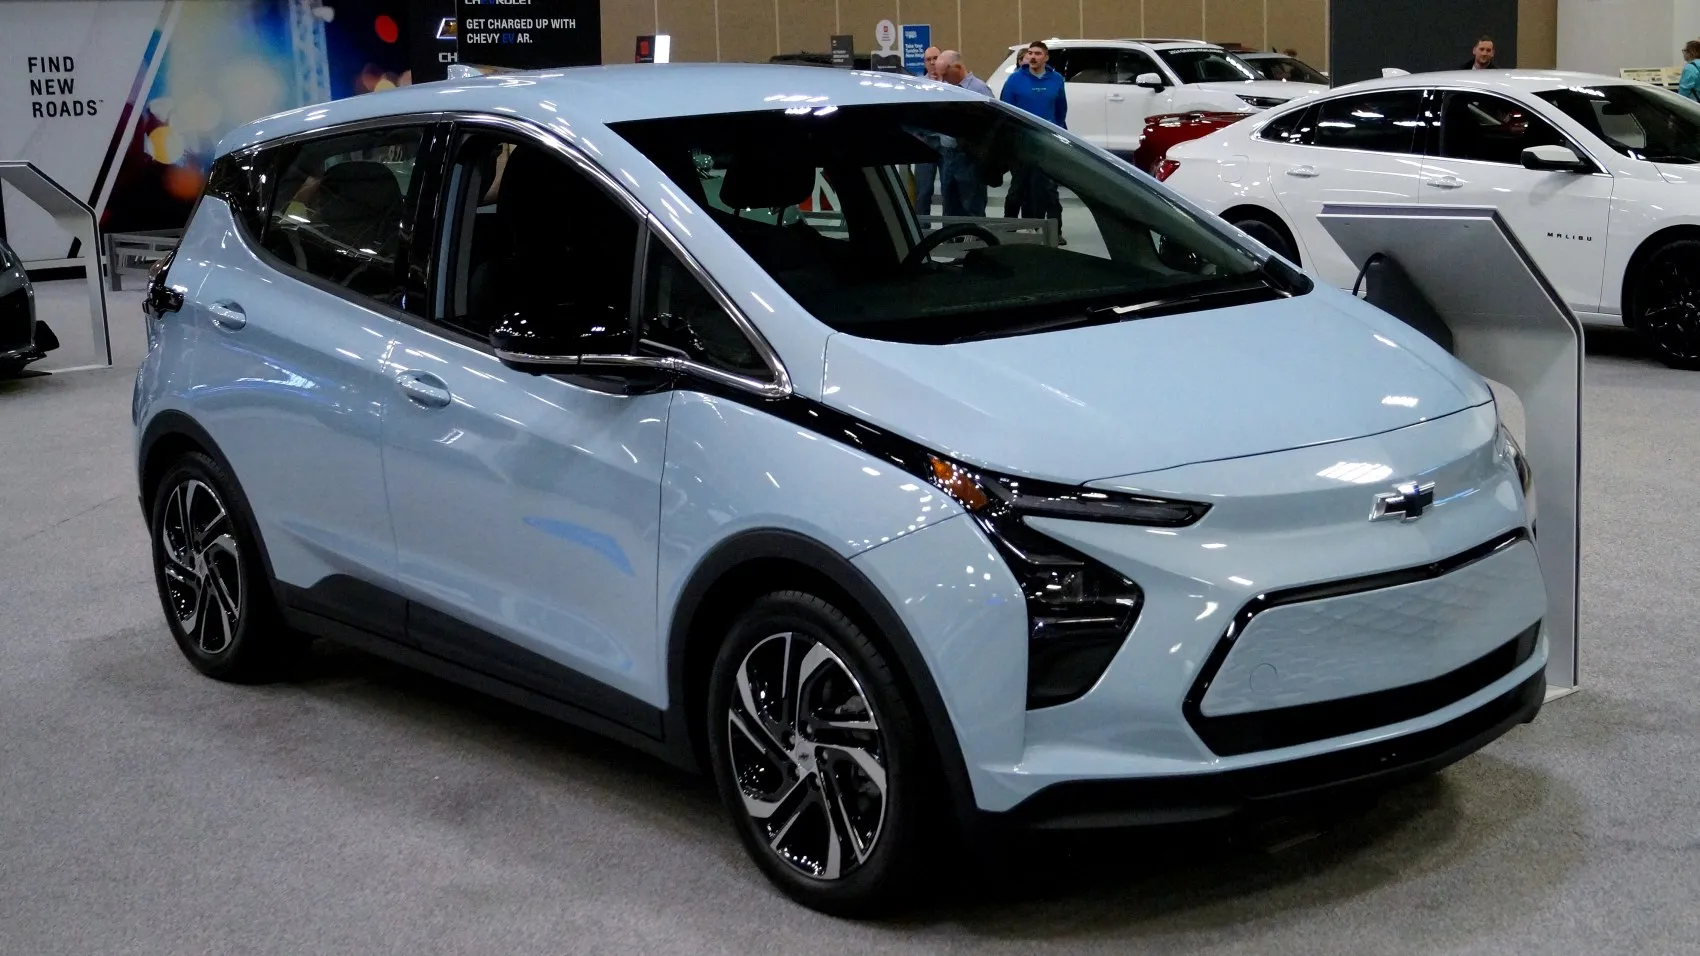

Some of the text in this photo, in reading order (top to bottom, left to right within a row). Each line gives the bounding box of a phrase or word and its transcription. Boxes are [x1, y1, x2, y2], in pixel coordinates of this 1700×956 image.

[466, 18, 576, 29] GET CHARGED UP WITH
[466, 33, 533, 44] CHEVY EV AR.
[438, 52, 458, 63] CH
[27, 56, 75, 73] FIND
[30, 78, 75, 96] NEW
[1547, 232, 1592, 242] MALIBU
